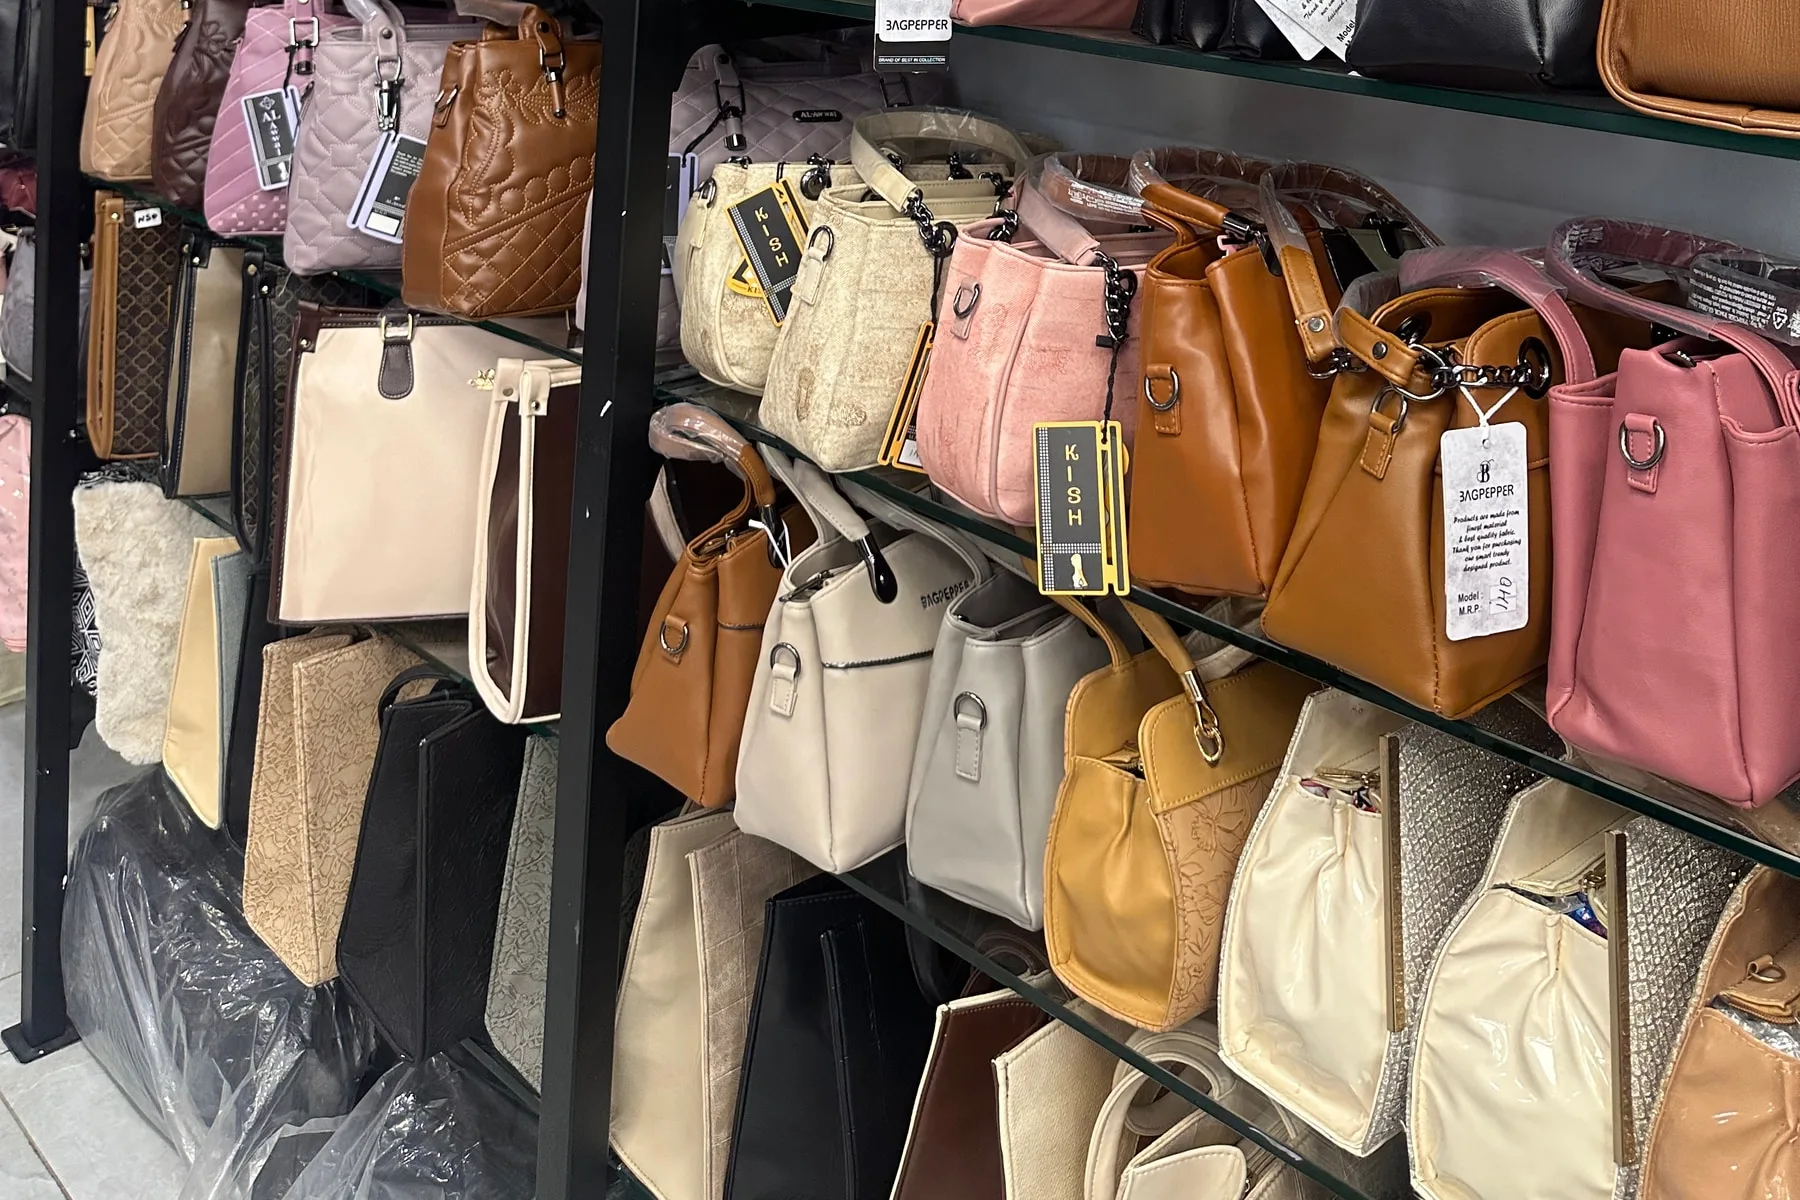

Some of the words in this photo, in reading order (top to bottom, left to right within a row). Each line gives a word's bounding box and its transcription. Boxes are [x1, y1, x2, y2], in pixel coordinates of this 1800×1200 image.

[1304, 4, 1318, 18] Thank
[754, 206, 789, 268] KISH
[1064, 444, 1083, 526] KISH
[1453, 514, 1479, 524] Products
[1490, 510, 1505, 519] made
[1507, 509, 1520, 518] from
[1466, 523, 1483, 533] finest
[1483, 520, 1507, 530] material
[1464, 534, 1476, 542] best
[1477, 530, 1497, 541] quality
[1452, 545, 1469, 554] Thank
[1471, 544, 1481, 553] you
[1483, 543, 1491, 551] for
[1492, 538, 1522, 549] purchasing
[1475, 552, 1491, 562] smart
[1493, 549, 1509, 557] trendy
[1463, 562, 1488, 572] designed
